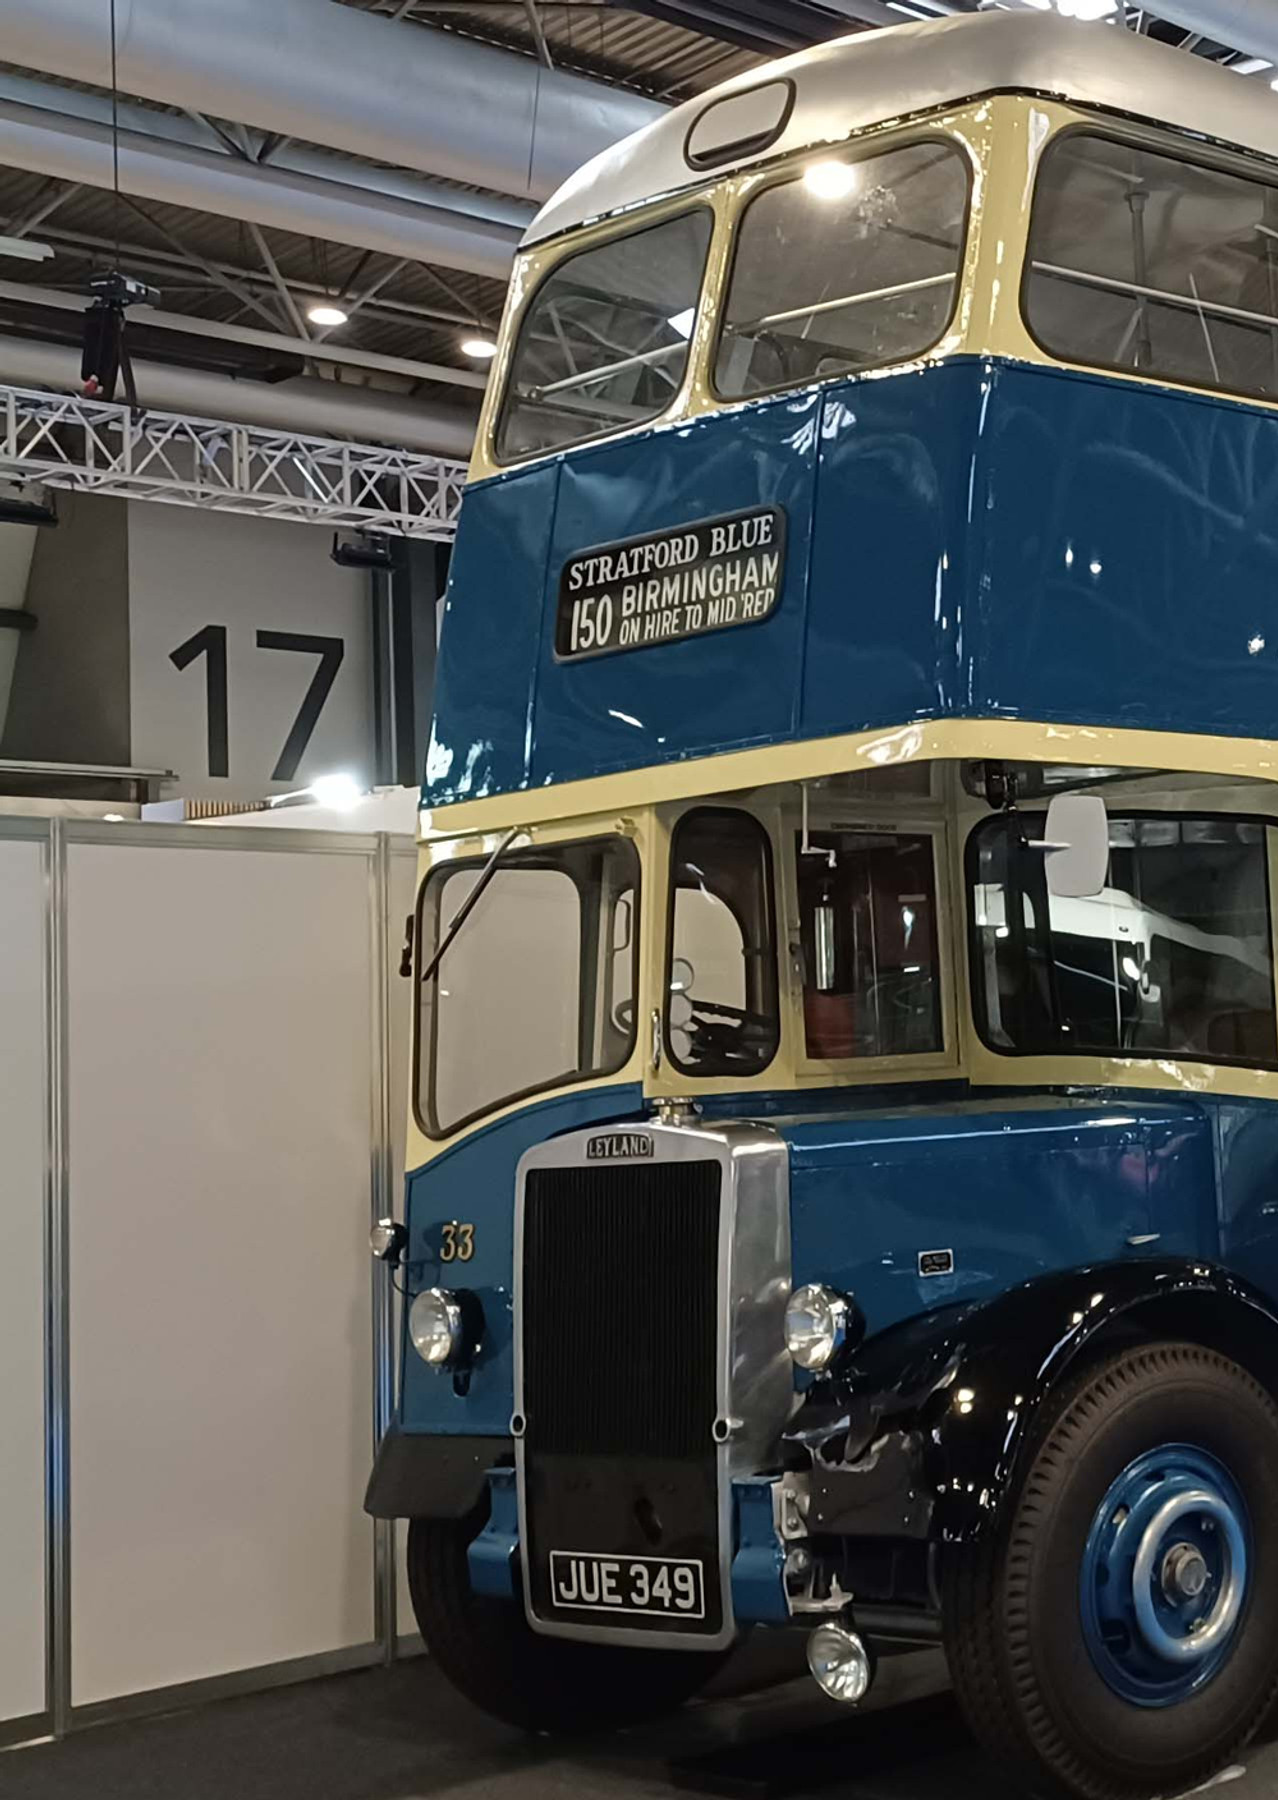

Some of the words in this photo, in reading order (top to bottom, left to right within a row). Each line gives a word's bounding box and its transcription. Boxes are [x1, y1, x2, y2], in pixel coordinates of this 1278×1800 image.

[569, 534, 699, 590] STRATFORD
[710, 514, 773, 557] BLUE
[622, 551, 779, 617] BIRMINGHAM
[571, 594, 613, 650] 150
[619, 617, 640, 645] ON
[644, 608, 682, 640] HIRE
[685, 604, 701, 631] TO
[707, 597, 737, 626] MID
[168, 624, 344, 781] 17
[589, 1136, 650, 1157] LEYLAND
[439, 1223, 475, 1261] 33
[559, 1560, 623, 1604] JUE
[629, 1563, 696, 1609] 349
